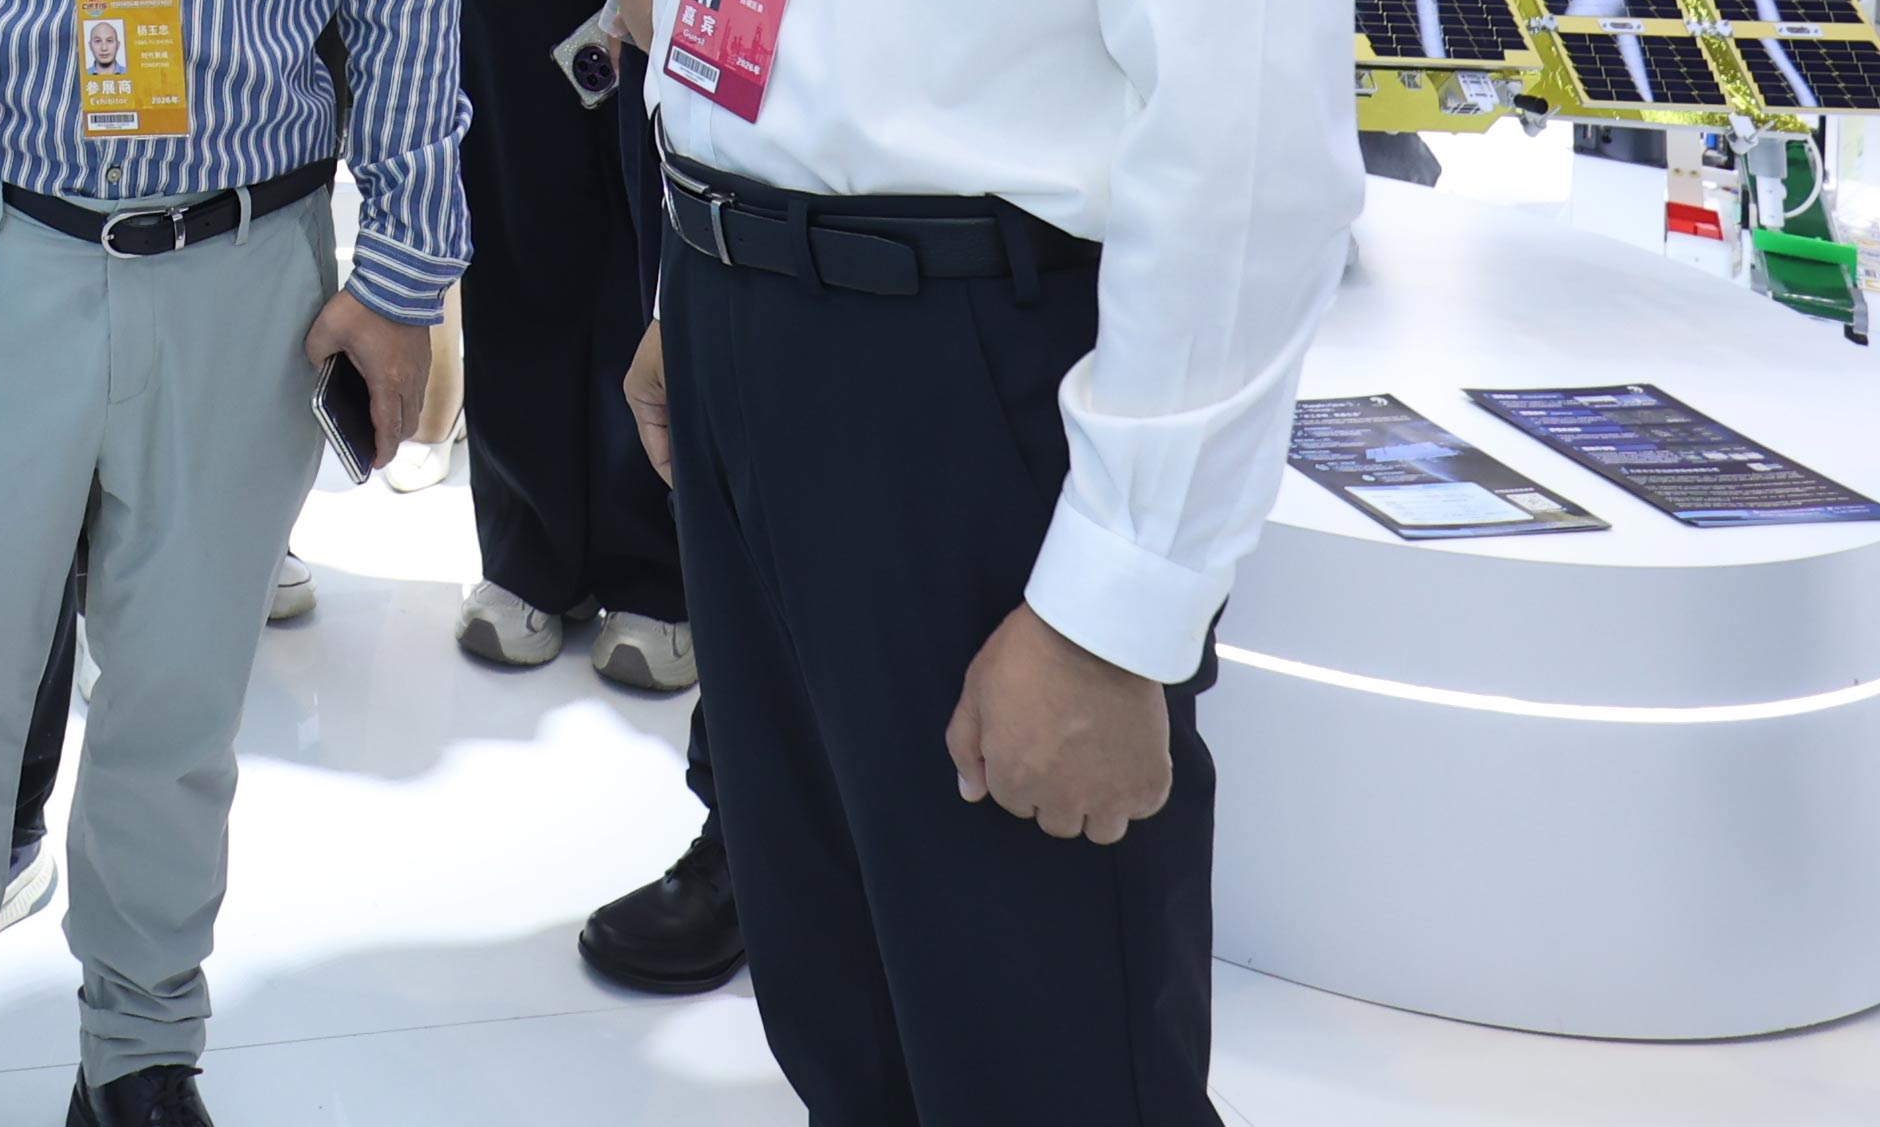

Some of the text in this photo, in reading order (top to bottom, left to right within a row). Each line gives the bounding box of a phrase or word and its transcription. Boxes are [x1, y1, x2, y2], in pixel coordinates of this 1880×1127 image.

[682, 5, 717, 36] 嘉宾
[683, 29, 705, 46] Guest
[86, 80, 132, 95] 参展商
[90, 97, 128, 105] Exhibitor
